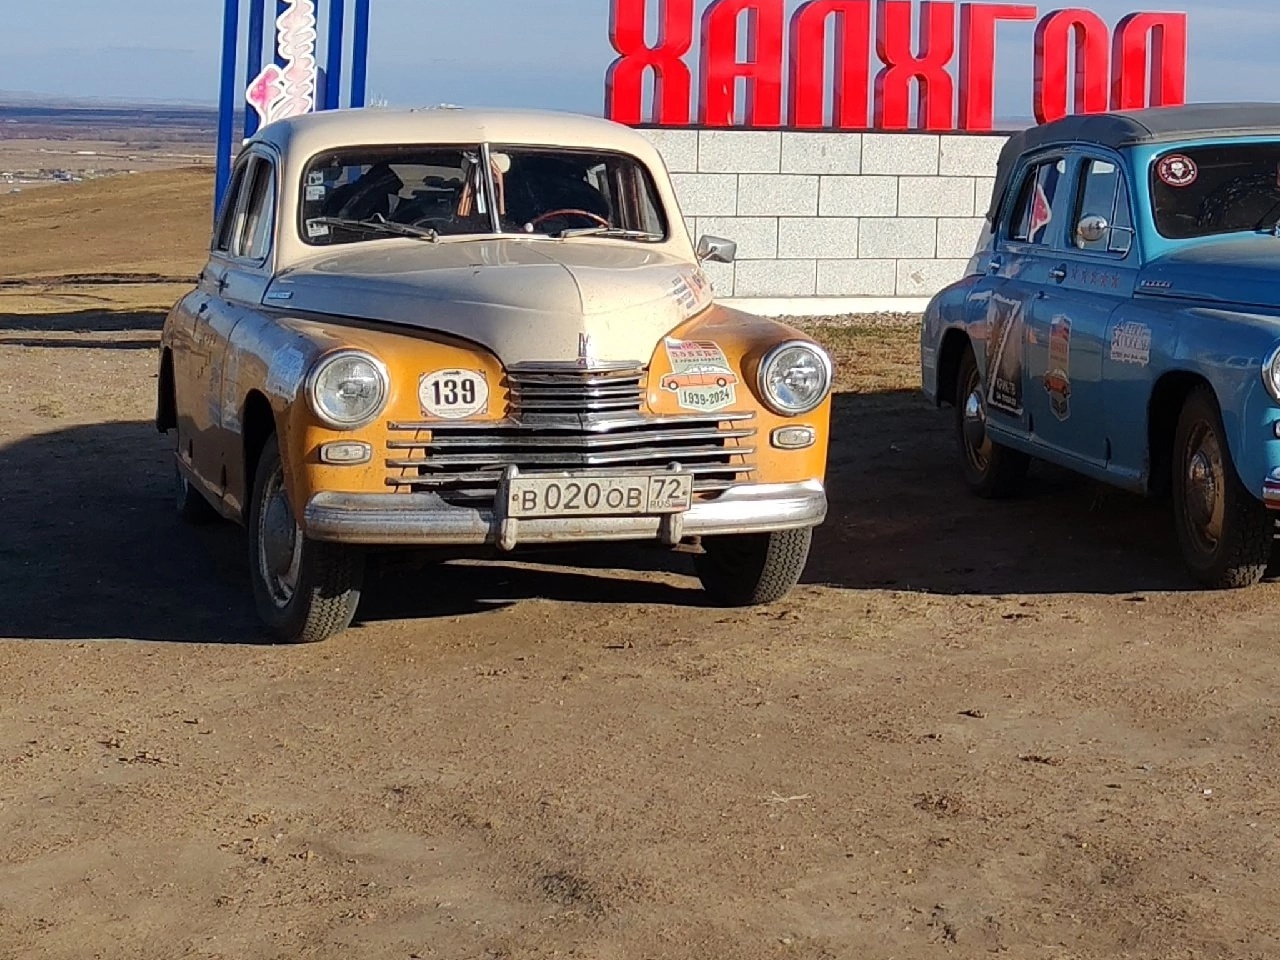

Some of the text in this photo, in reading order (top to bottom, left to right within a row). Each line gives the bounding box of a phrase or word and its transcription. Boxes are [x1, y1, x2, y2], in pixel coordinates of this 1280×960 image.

[432, 378, 476, 405] 139
[683, 389, 730, 406] 1939-2024
[653, 478, 682, 500] 72
[650, 500, 671, 509] RUS
